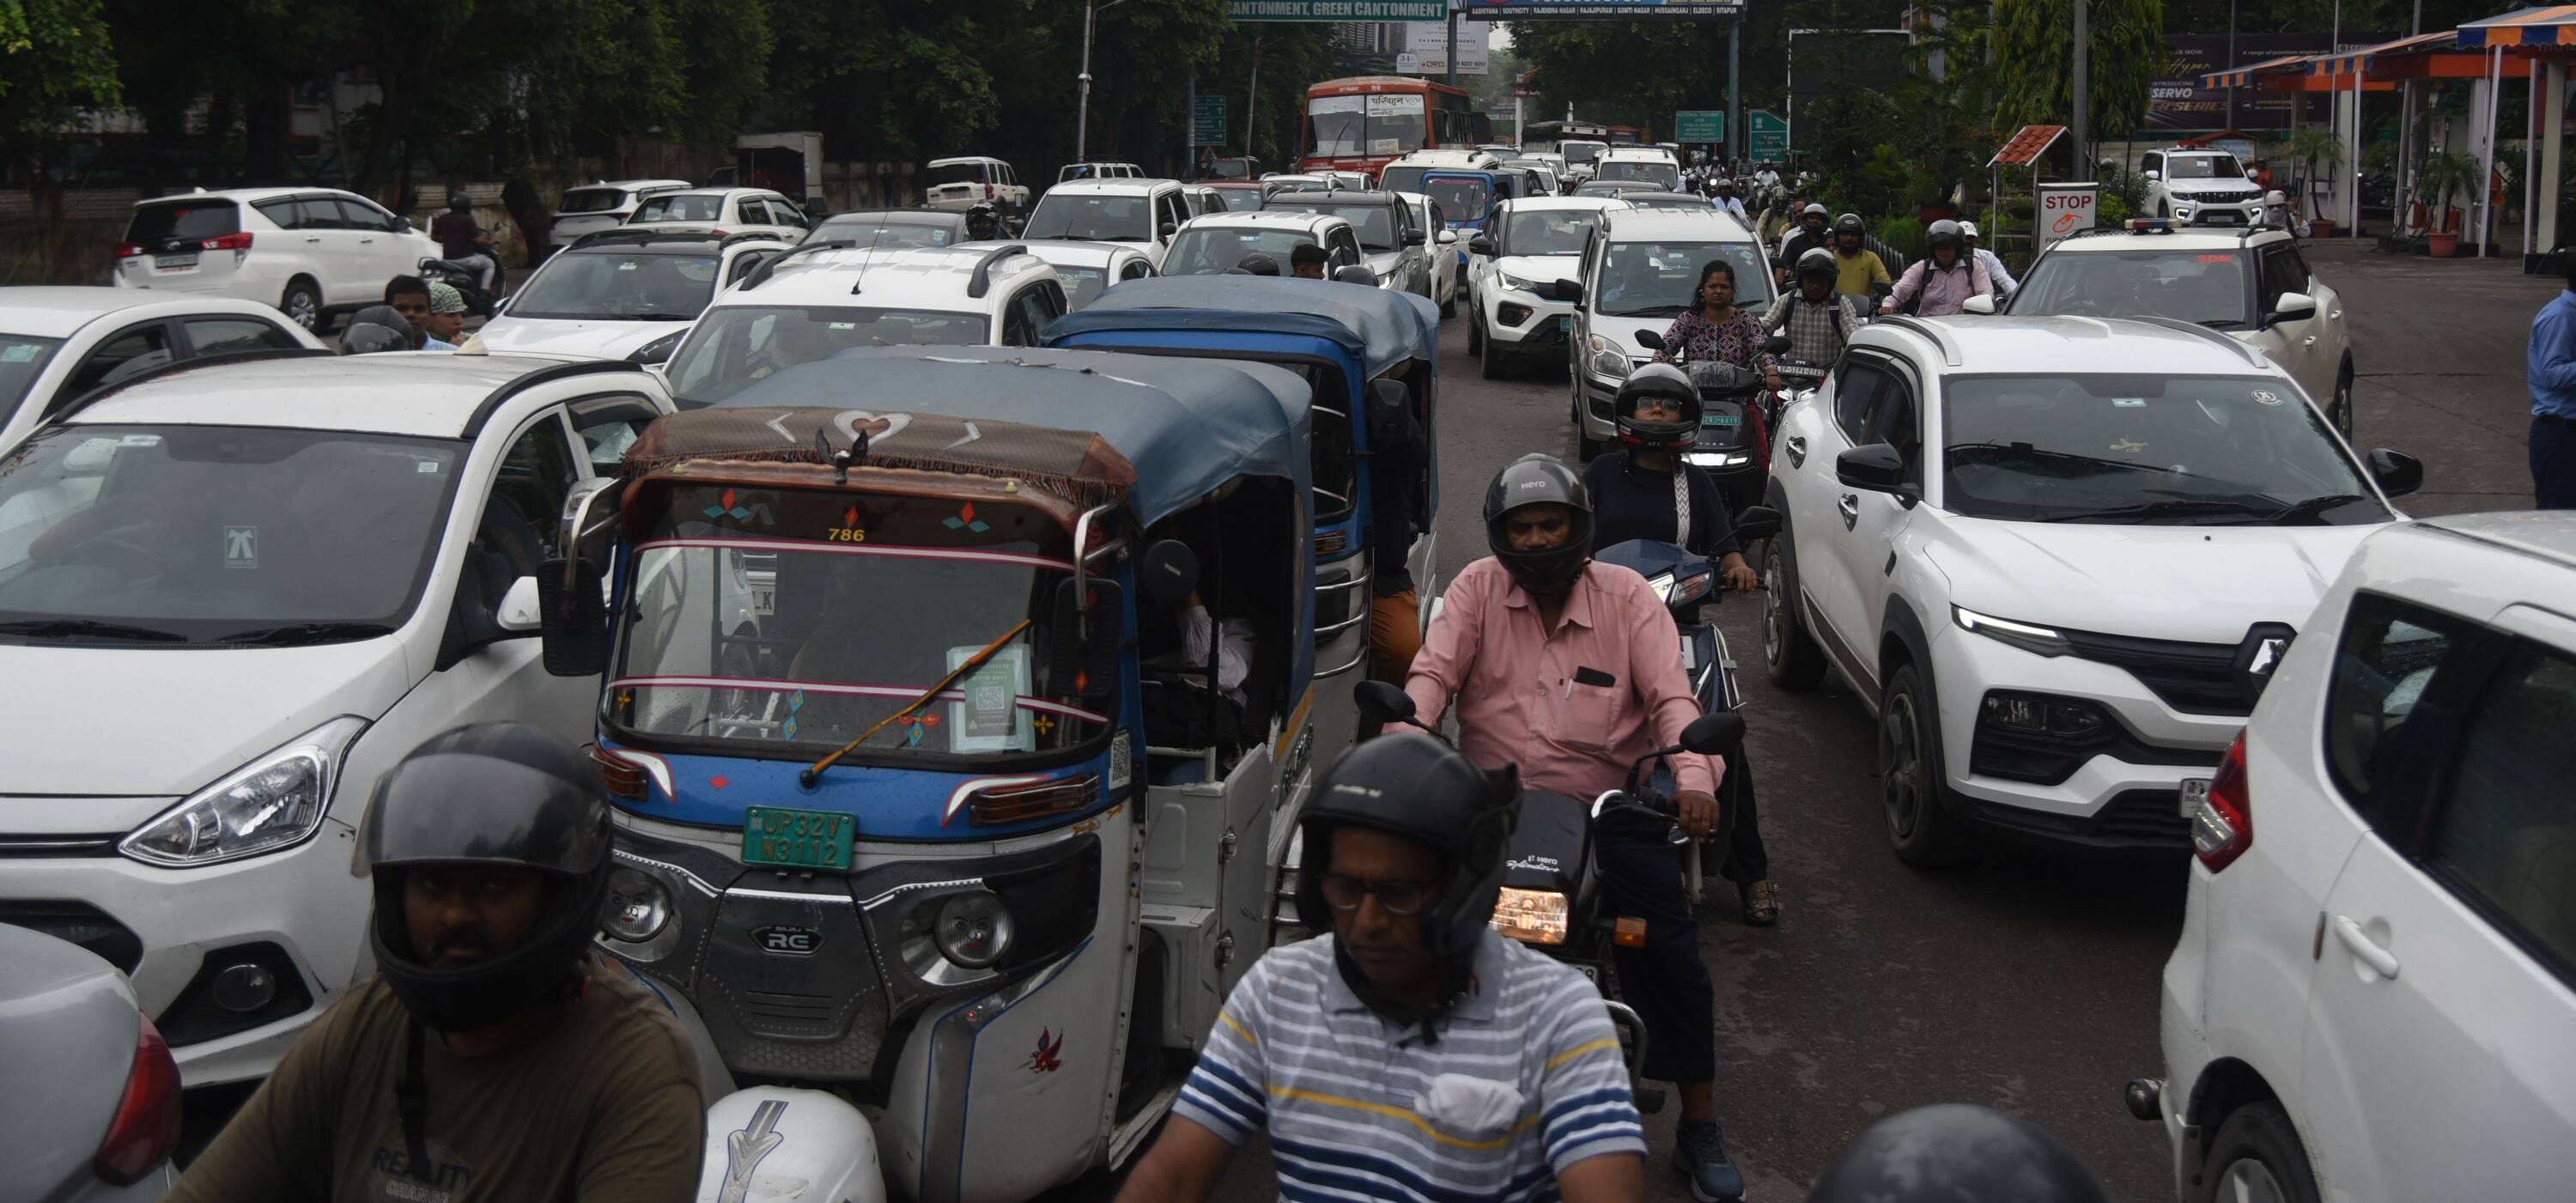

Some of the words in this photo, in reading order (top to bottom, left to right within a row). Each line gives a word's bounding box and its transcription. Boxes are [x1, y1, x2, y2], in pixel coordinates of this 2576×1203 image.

[1313, 3, 1352, 15] GREEN
[1355, 3, 1443, 17] CANTONMENT
[2151, 88, 2192, 99] SERVO
[2045, 196, 2092, 210] STOP
[1521, 480, 1546, 490] Hero
[828, 527, 866, 543] 786
[764, 811, 841, 838] UP32V
[762, 836, 839, 866] N3112
